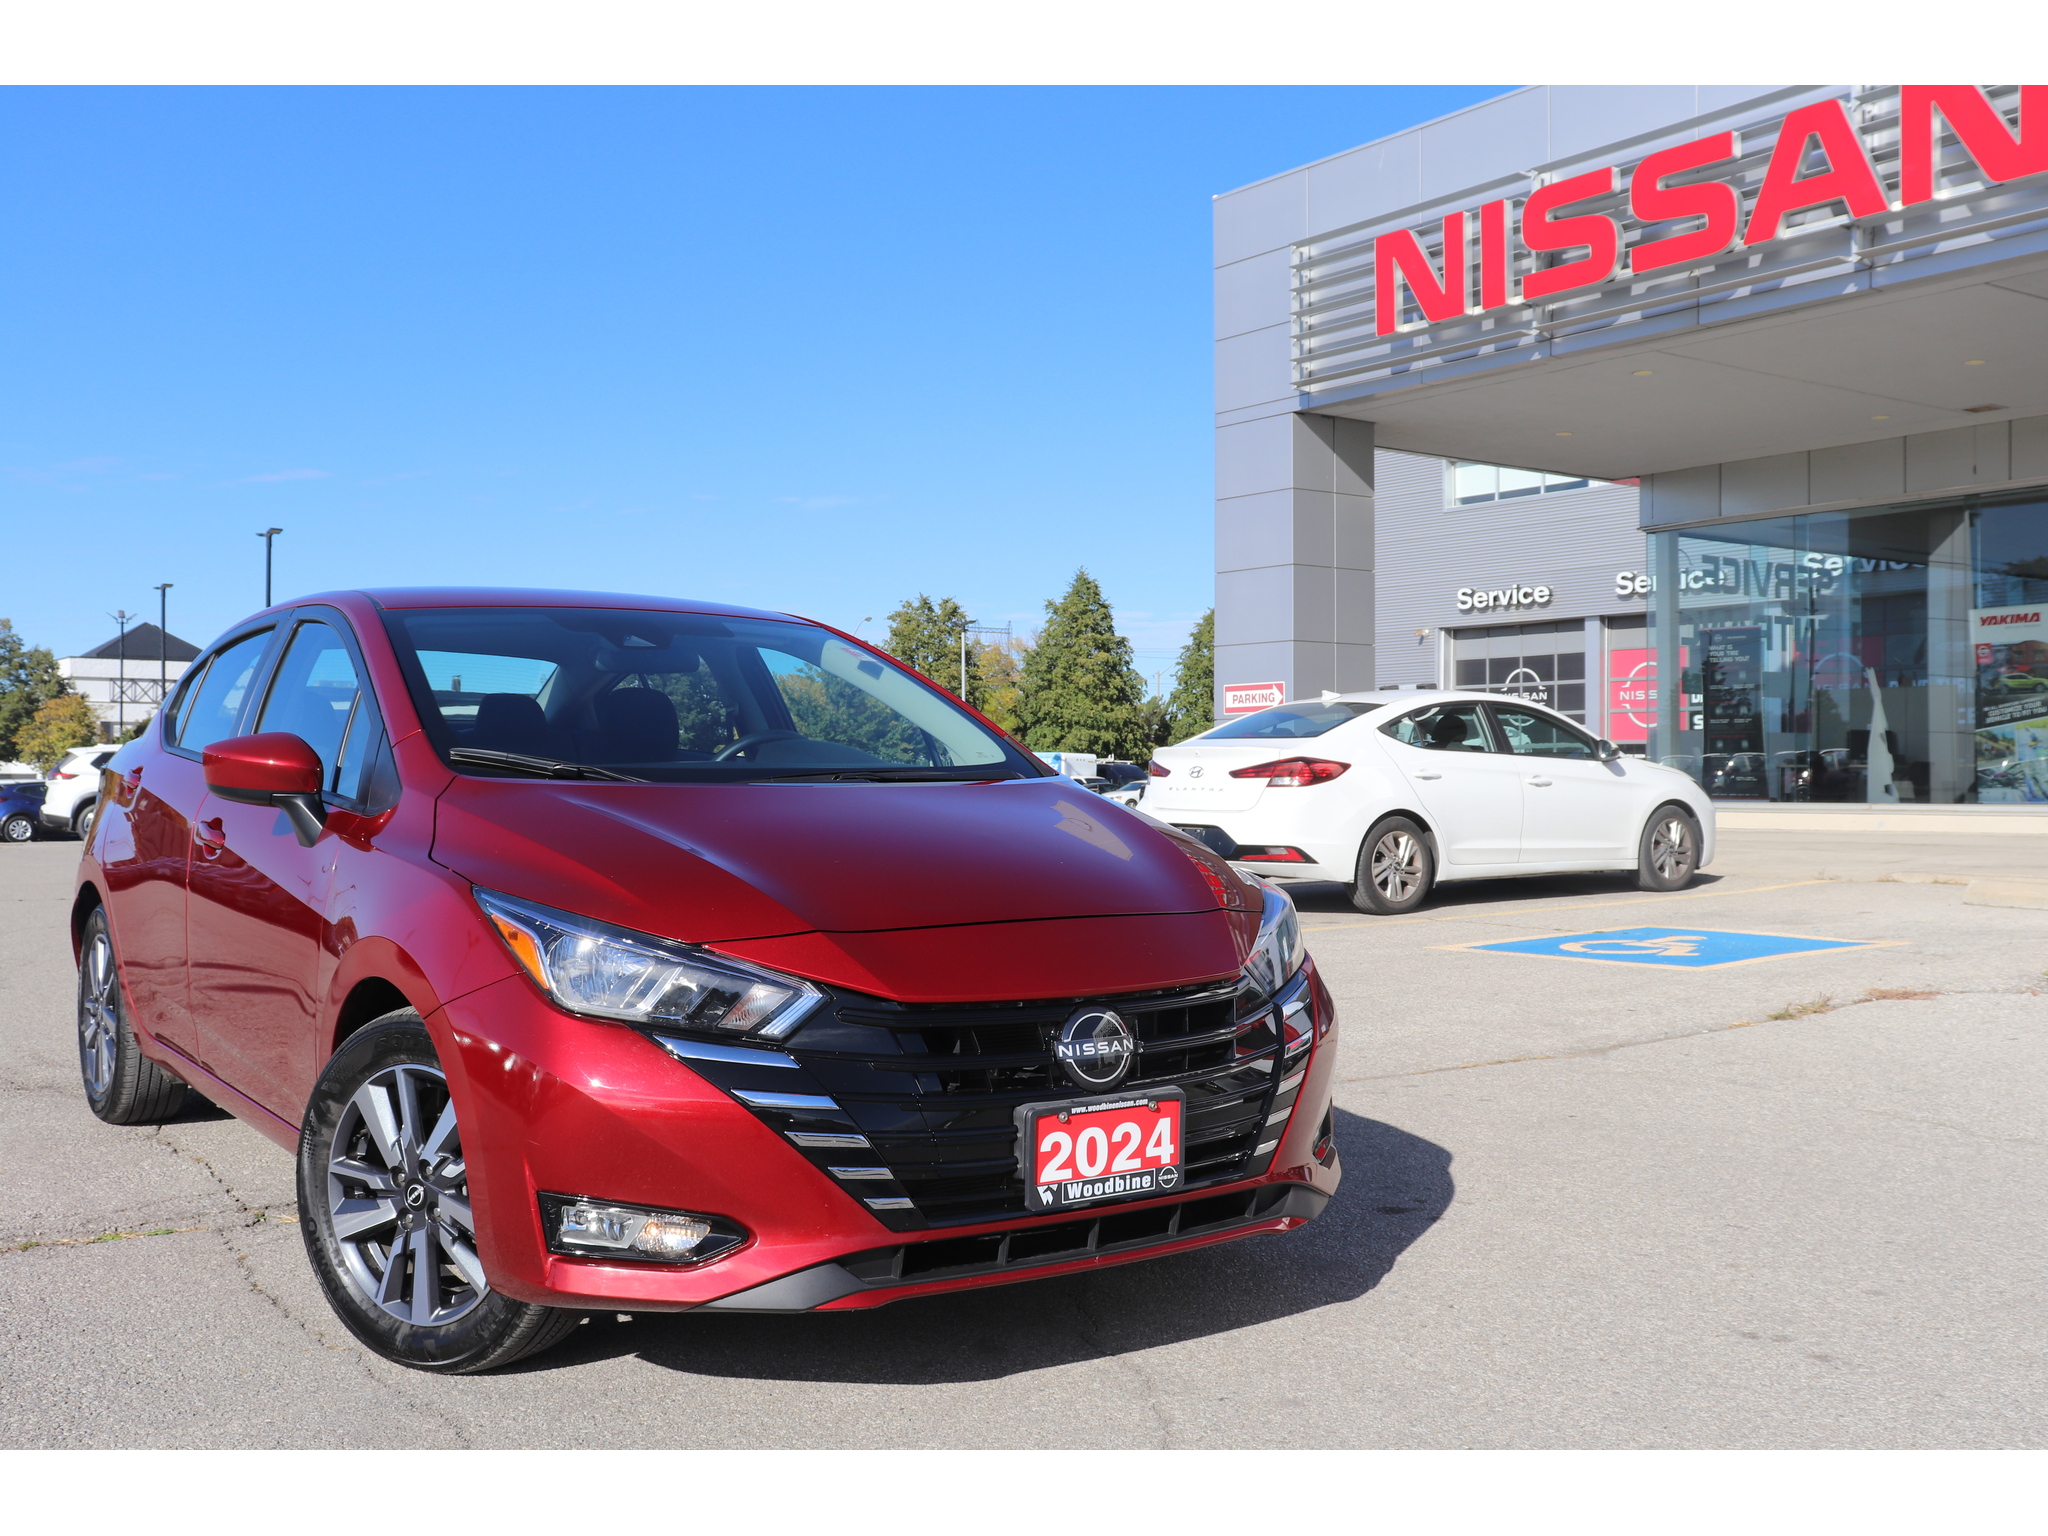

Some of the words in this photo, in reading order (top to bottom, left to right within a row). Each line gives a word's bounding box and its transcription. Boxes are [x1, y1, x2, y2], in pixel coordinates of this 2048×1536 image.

[1374, 86, 2048, 338] NISSAN
[1615, 568, 1726, 595] Serice
[1456, 584, 1552, 610] Service
[1980, 612, 2041, 626] YAKIMA
[1232, 692, 1276, 705] PARKING
[1619, 690, 1658, 701] NISS
[1987, 704, 2023, 717] CUSTOMIZE
[2023, 700, 2042, 709] YOUR
[1985, 713, 2011, 724] VEHICLE
[1057, 1038, 1134, 1059] NISSAN
[1071, 1098, 1149, 1114] www.woodbinenissan.com
[1039, 1117, 1175, 1184] 2024
[1158, 1172, 1179, 1181] NISSAN
[1066, 1174, 1151, 1200] Woodbine
